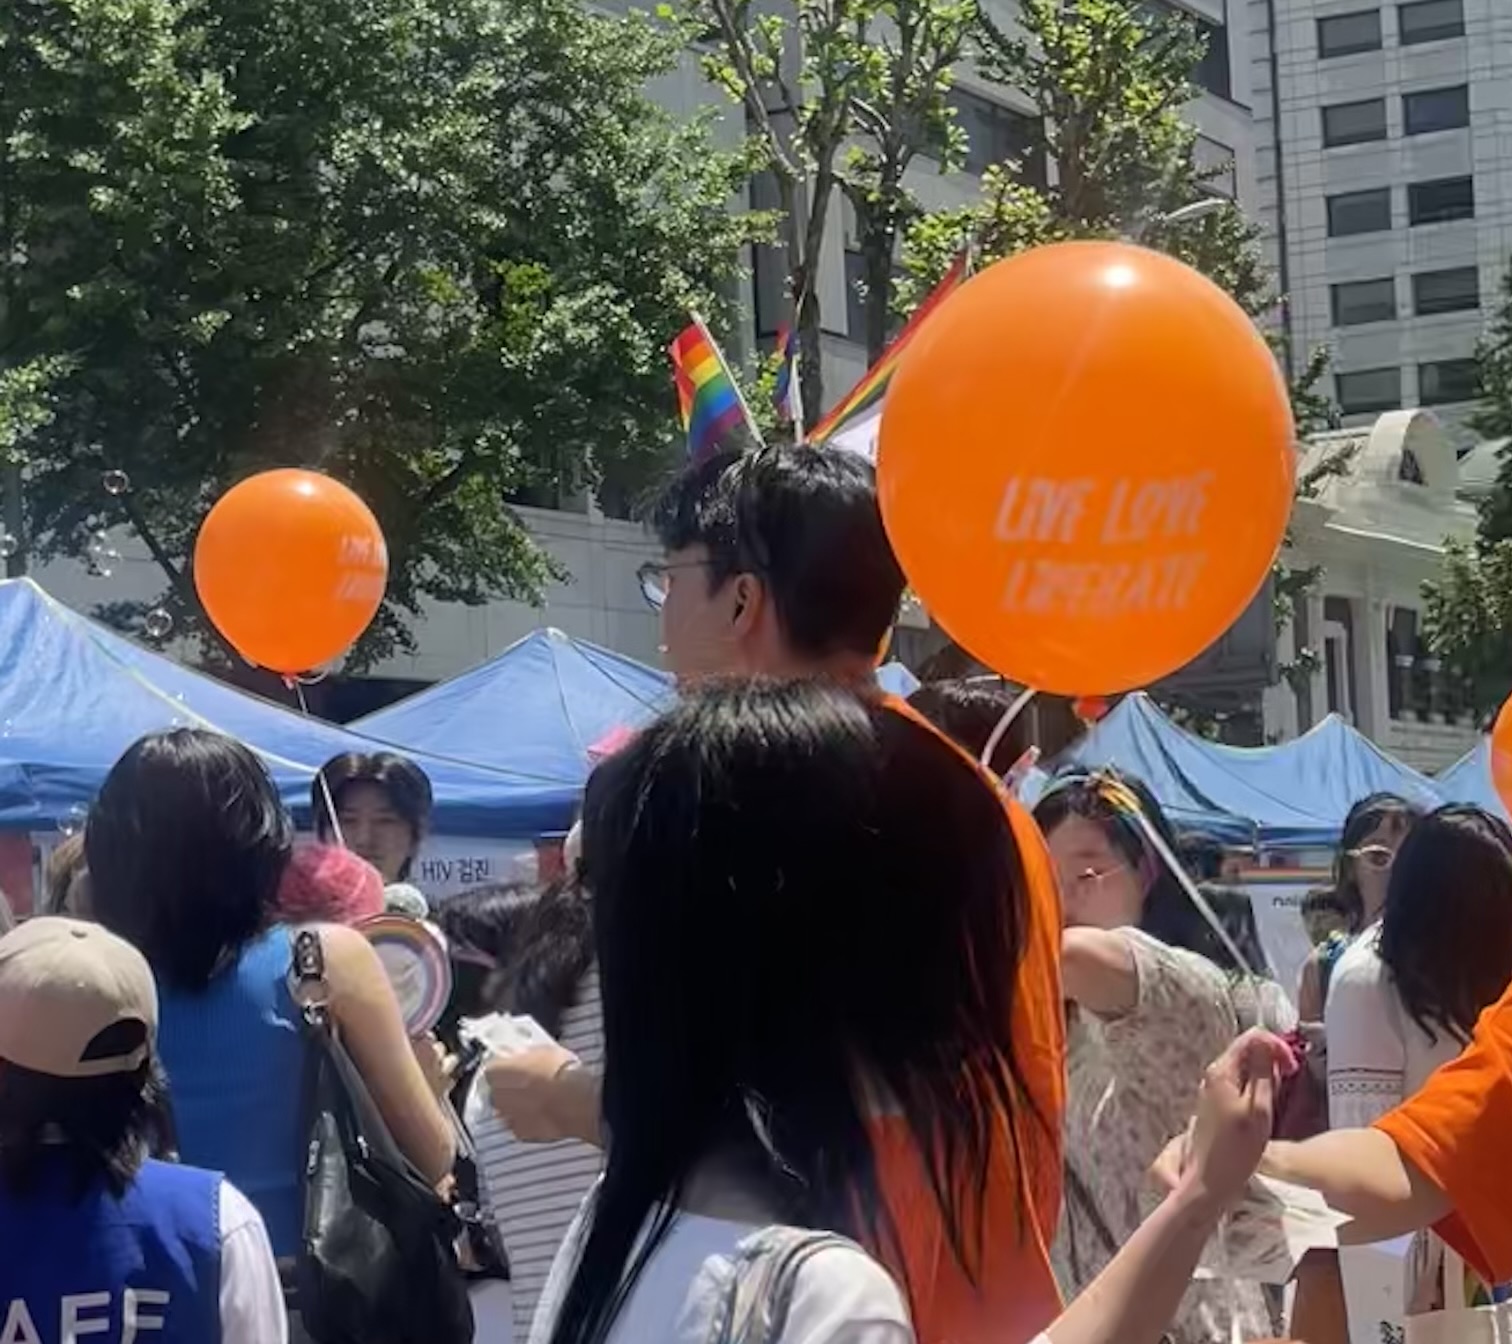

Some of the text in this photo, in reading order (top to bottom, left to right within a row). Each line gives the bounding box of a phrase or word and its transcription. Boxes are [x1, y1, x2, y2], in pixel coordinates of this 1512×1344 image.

[1099, 469, 1217, 544] LOVE
[421, 855, 489, 884] HIV 검진
